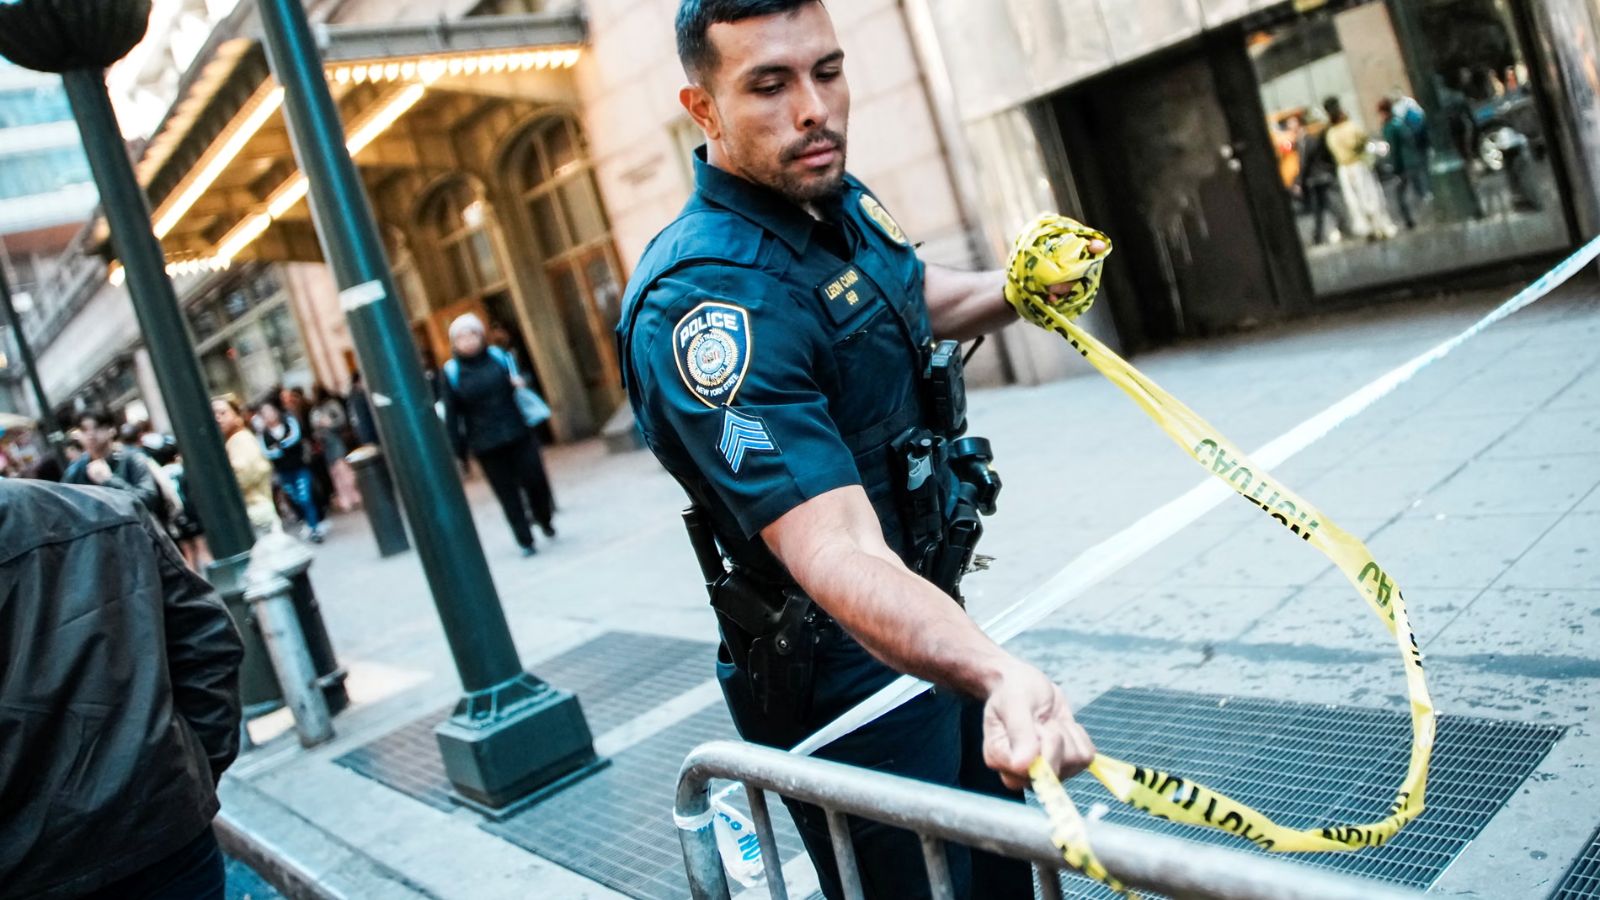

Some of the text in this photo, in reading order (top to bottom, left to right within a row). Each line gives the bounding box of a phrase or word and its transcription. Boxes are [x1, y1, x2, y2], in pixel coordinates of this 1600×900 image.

[679, 312, 739, 348] POLICE
[696, 373, 739, 397] NEW YORK STATE
